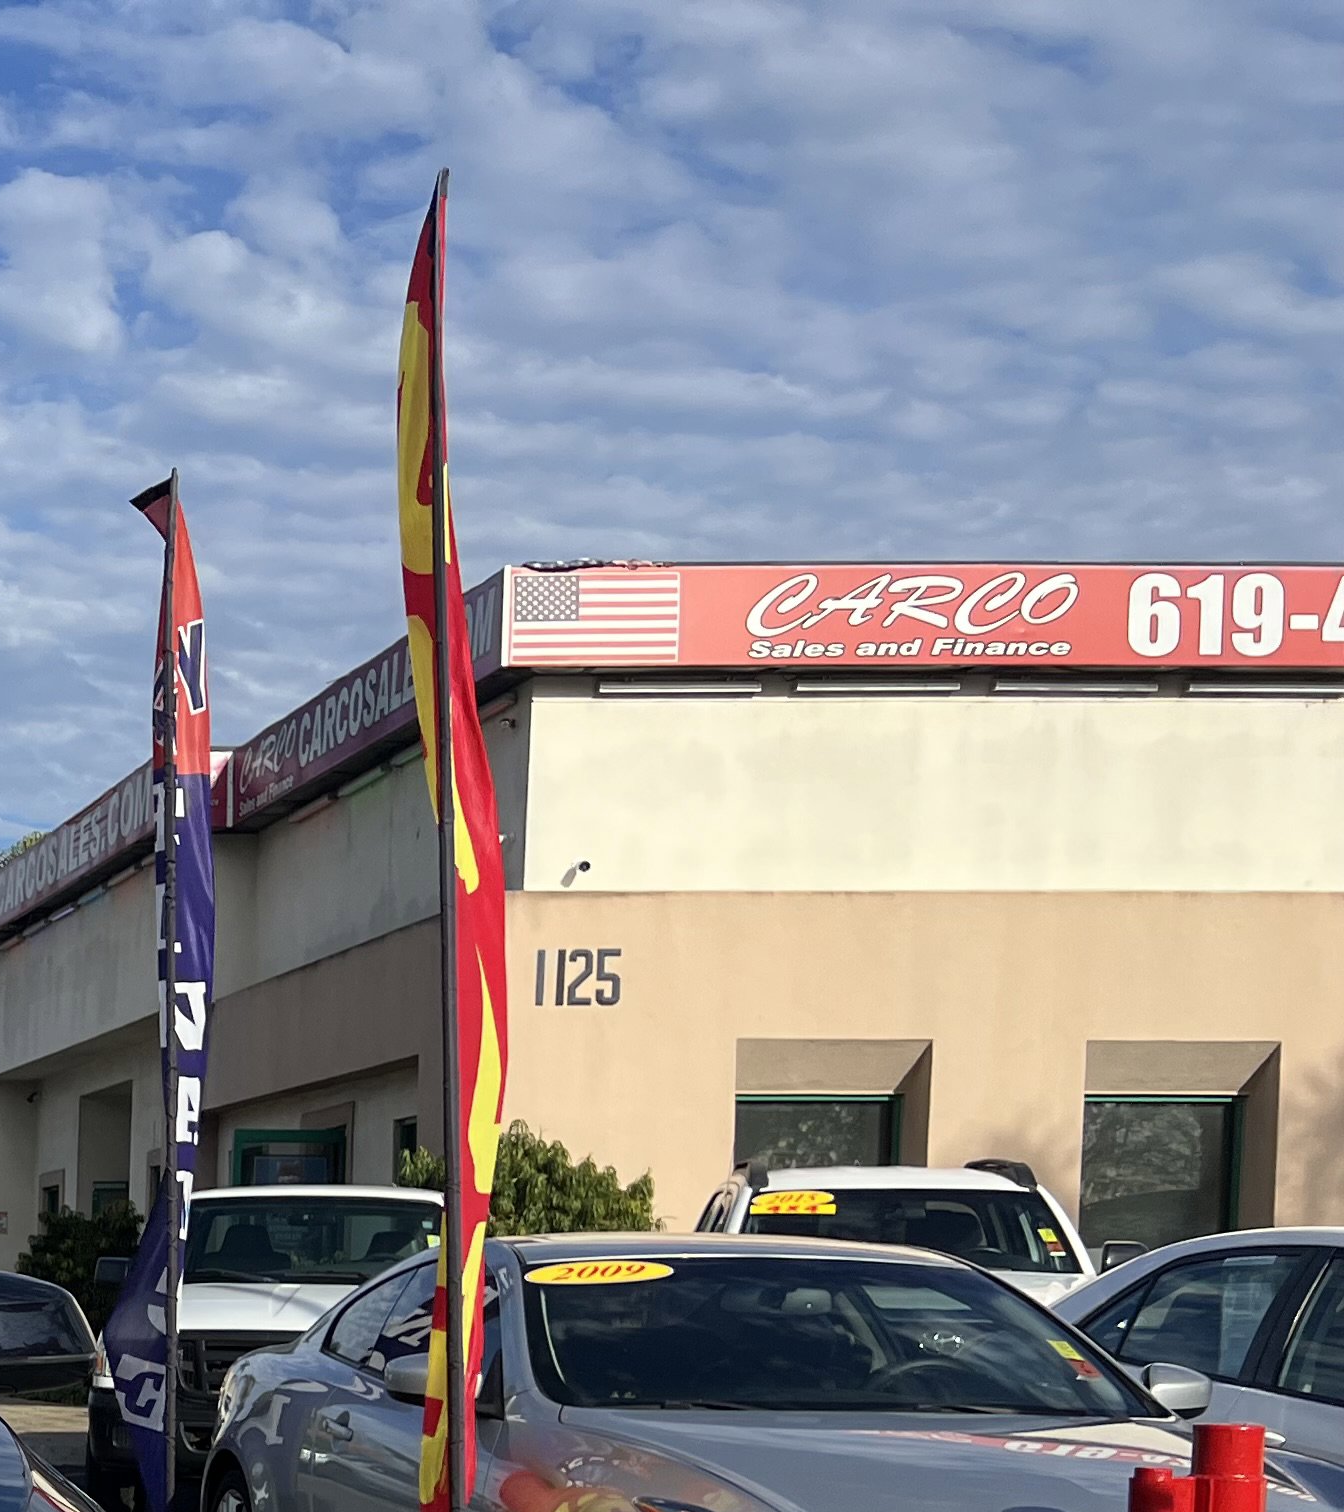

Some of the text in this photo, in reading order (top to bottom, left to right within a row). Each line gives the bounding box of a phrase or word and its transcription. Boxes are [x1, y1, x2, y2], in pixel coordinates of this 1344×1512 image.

[745, 571, 1080, 639] CARCO
[748, 637, 1072, 660] Sales and Finance
[239, 718, 298, 795] CARCO
[534, 948, 623, 1007] 1125
[551, 1263, 647, 1281] 2009
